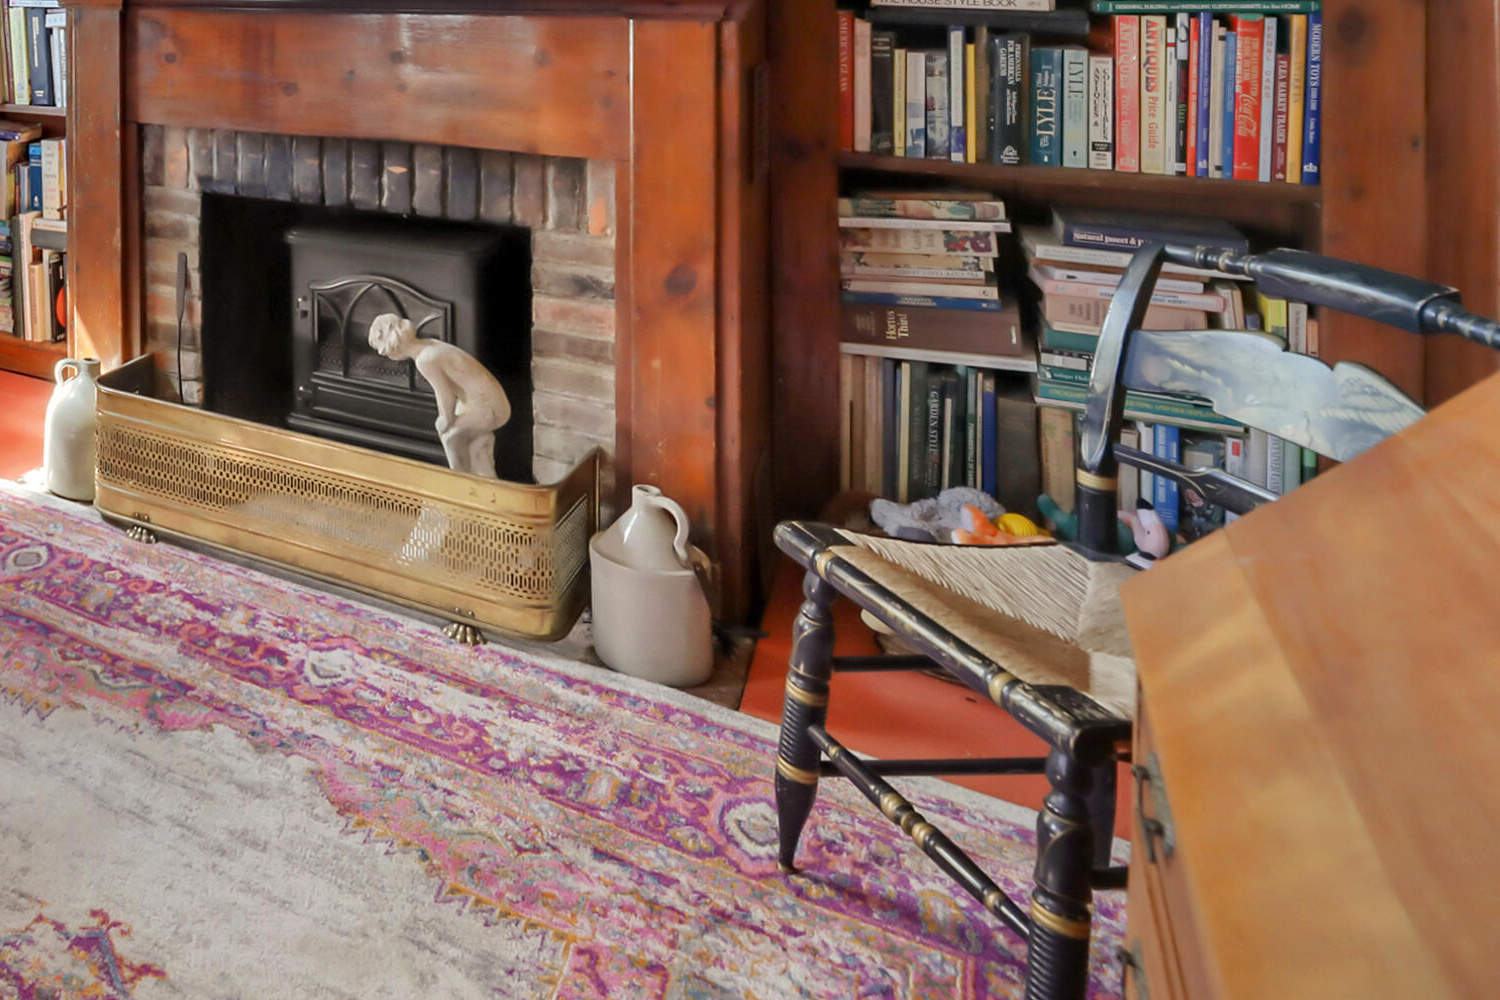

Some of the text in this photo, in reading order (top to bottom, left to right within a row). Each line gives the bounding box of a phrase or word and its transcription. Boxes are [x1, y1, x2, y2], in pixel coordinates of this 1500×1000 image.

[1068, 61, 1084, 99] LYLE
[1309, 23, 1321, 87] MODERN TOYS
[1145, 19, 1159, 149] ANTIQUES Price Guide
[1276, 60, 1287, 144] FLEA MARKET TRADER
[1036, 90, 1056, 137] LYLE
[1072, 232, 1104, 242] Natural
